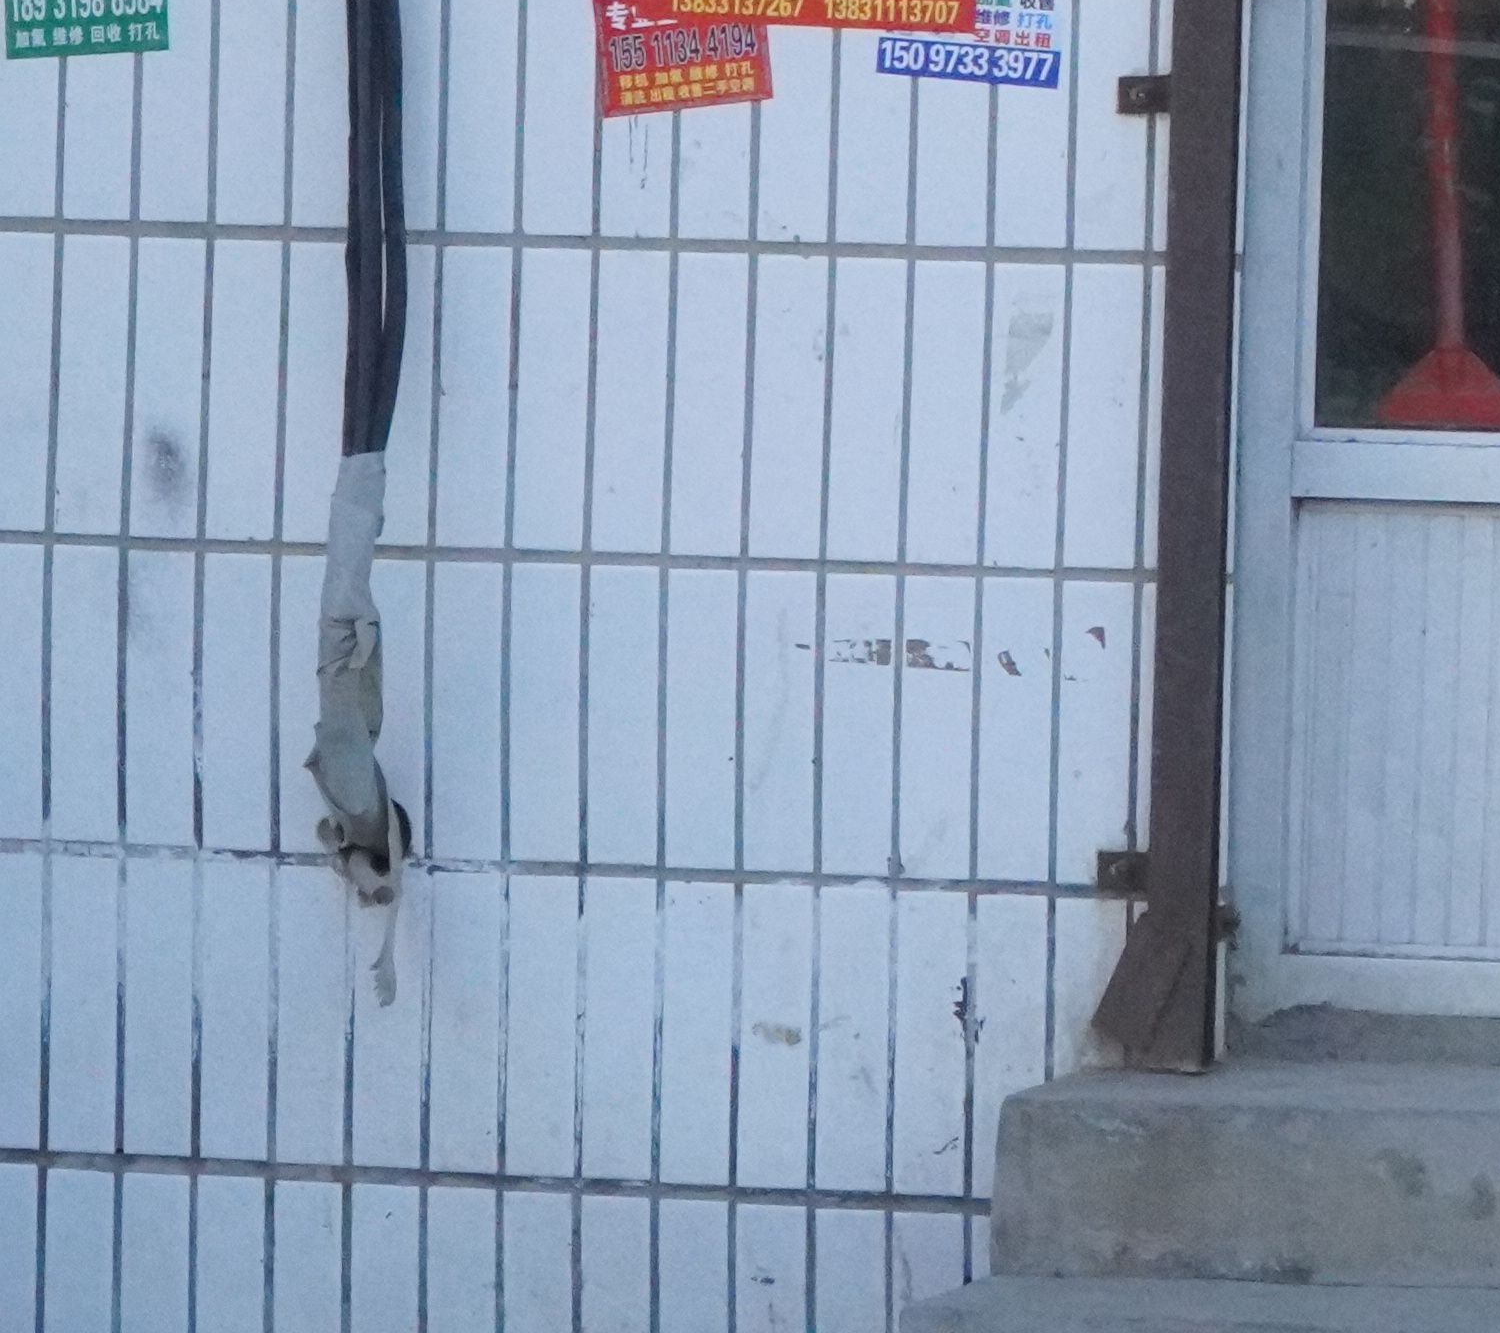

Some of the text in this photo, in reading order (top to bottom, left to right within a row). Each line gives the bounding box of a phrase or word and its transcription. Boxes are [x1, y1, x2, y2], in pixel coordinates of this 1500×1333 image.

[975, 8, 1053, 30] 维修 打孔
[90, 23, 122, 44] 回收
[127, 21, 160, 43] 打孔
[973, 29, 1052, 49] 空调出租
[608, 22, 758, 73] 155 1134 4194
[880, 39, 1055, 82] 150 9733 3977
